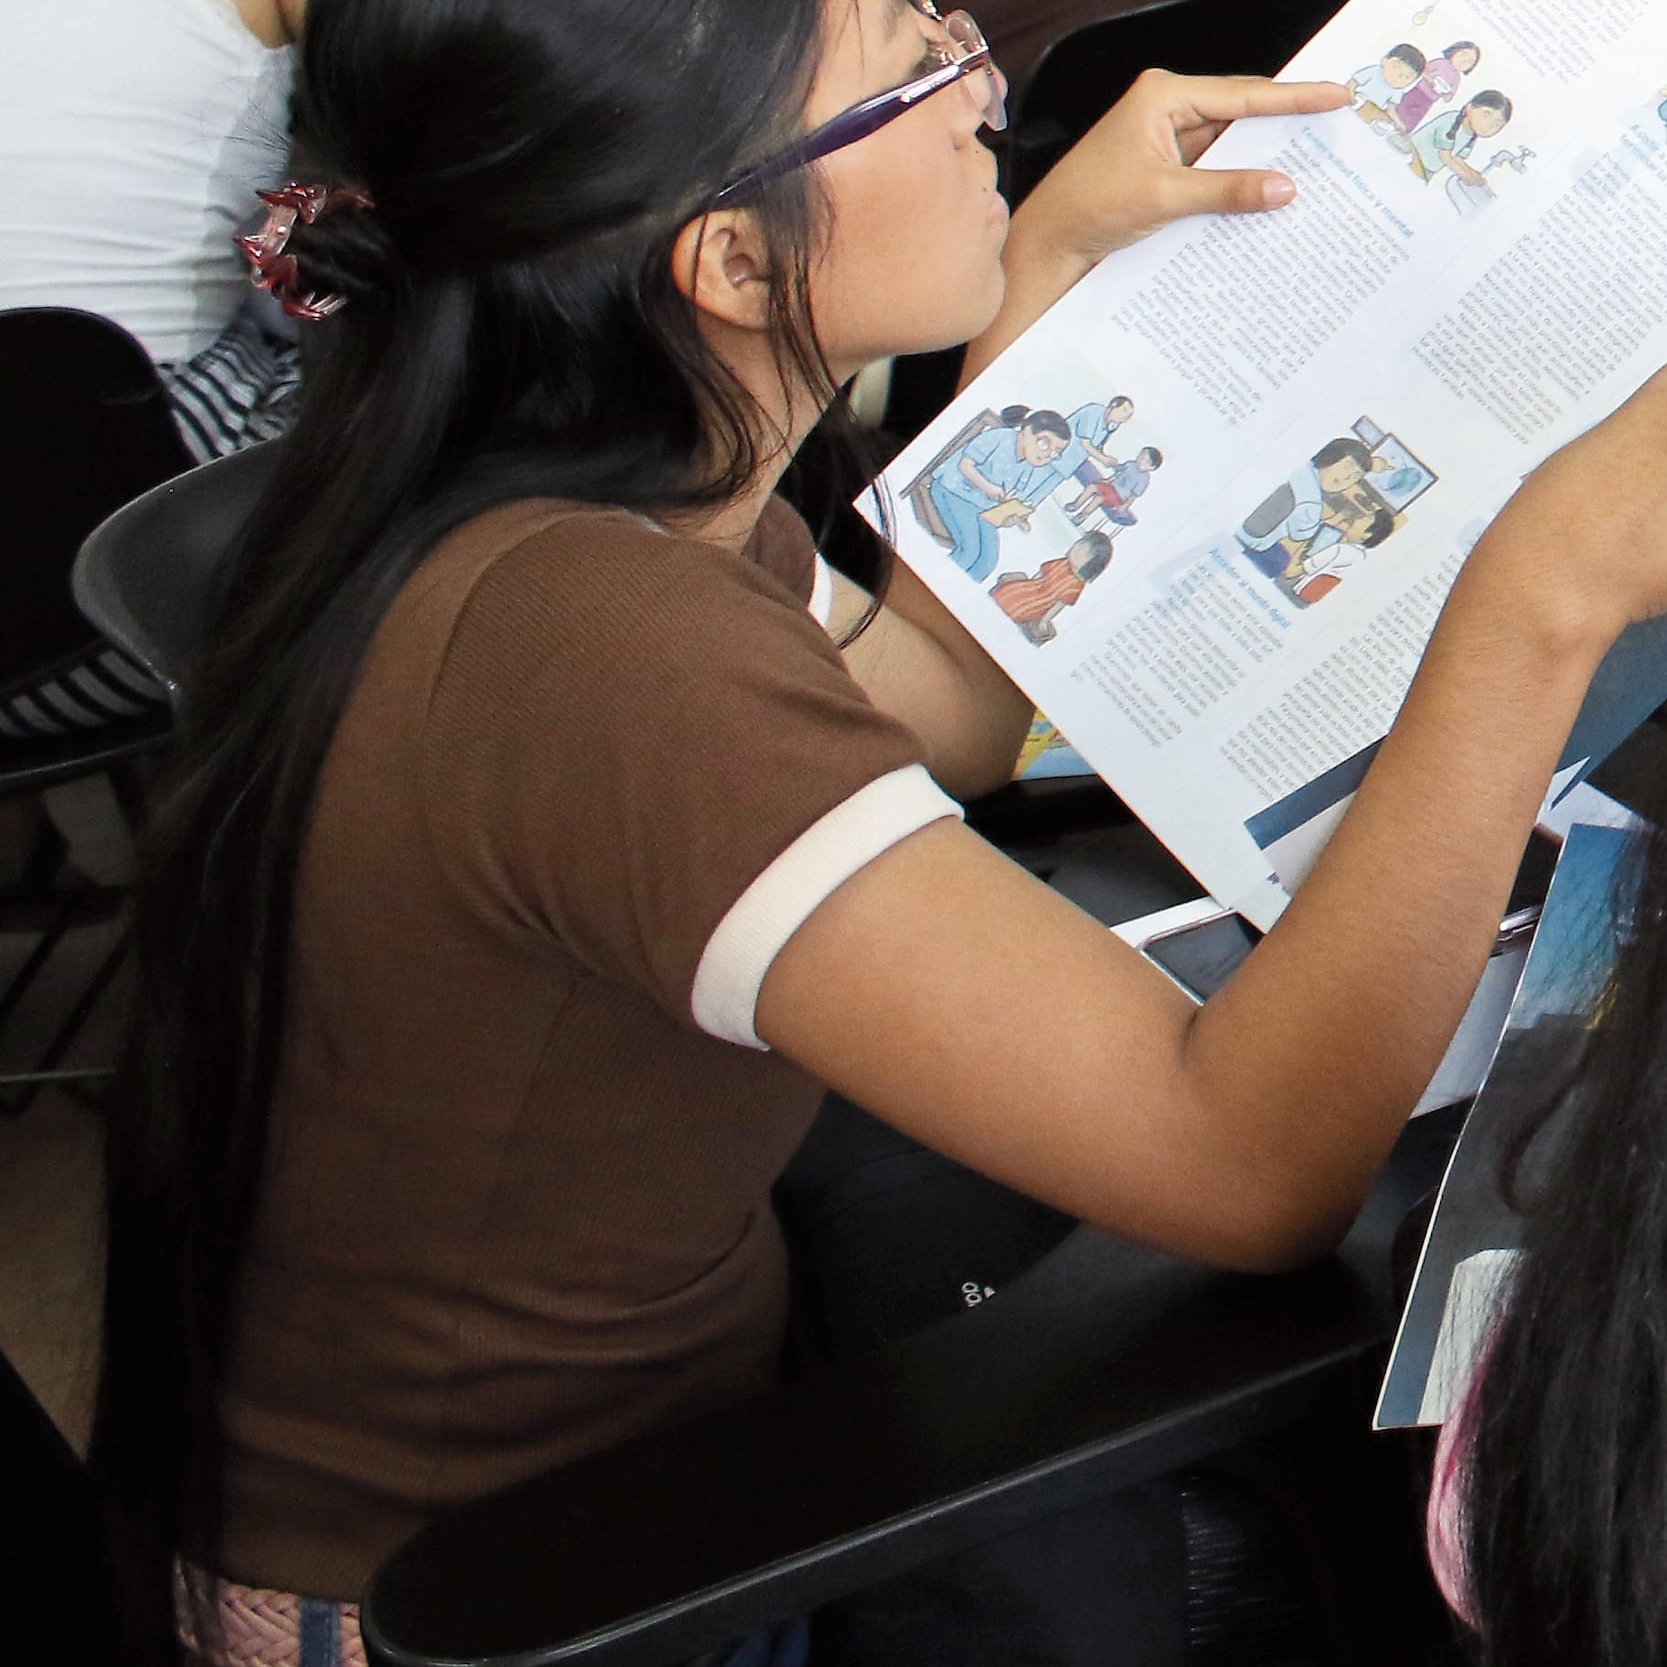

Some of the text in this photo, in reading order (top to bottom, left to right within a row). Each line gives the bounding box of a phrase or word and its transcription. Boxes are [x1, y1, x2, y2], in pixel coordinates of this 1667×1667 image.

[1619, 132, 1660, 173] terminar
[1629, 122, 1661, 153] Asistir
[1657, 151, 1666, 160] a
[1298, 125, 1416, 239] Tener salud física y mental
